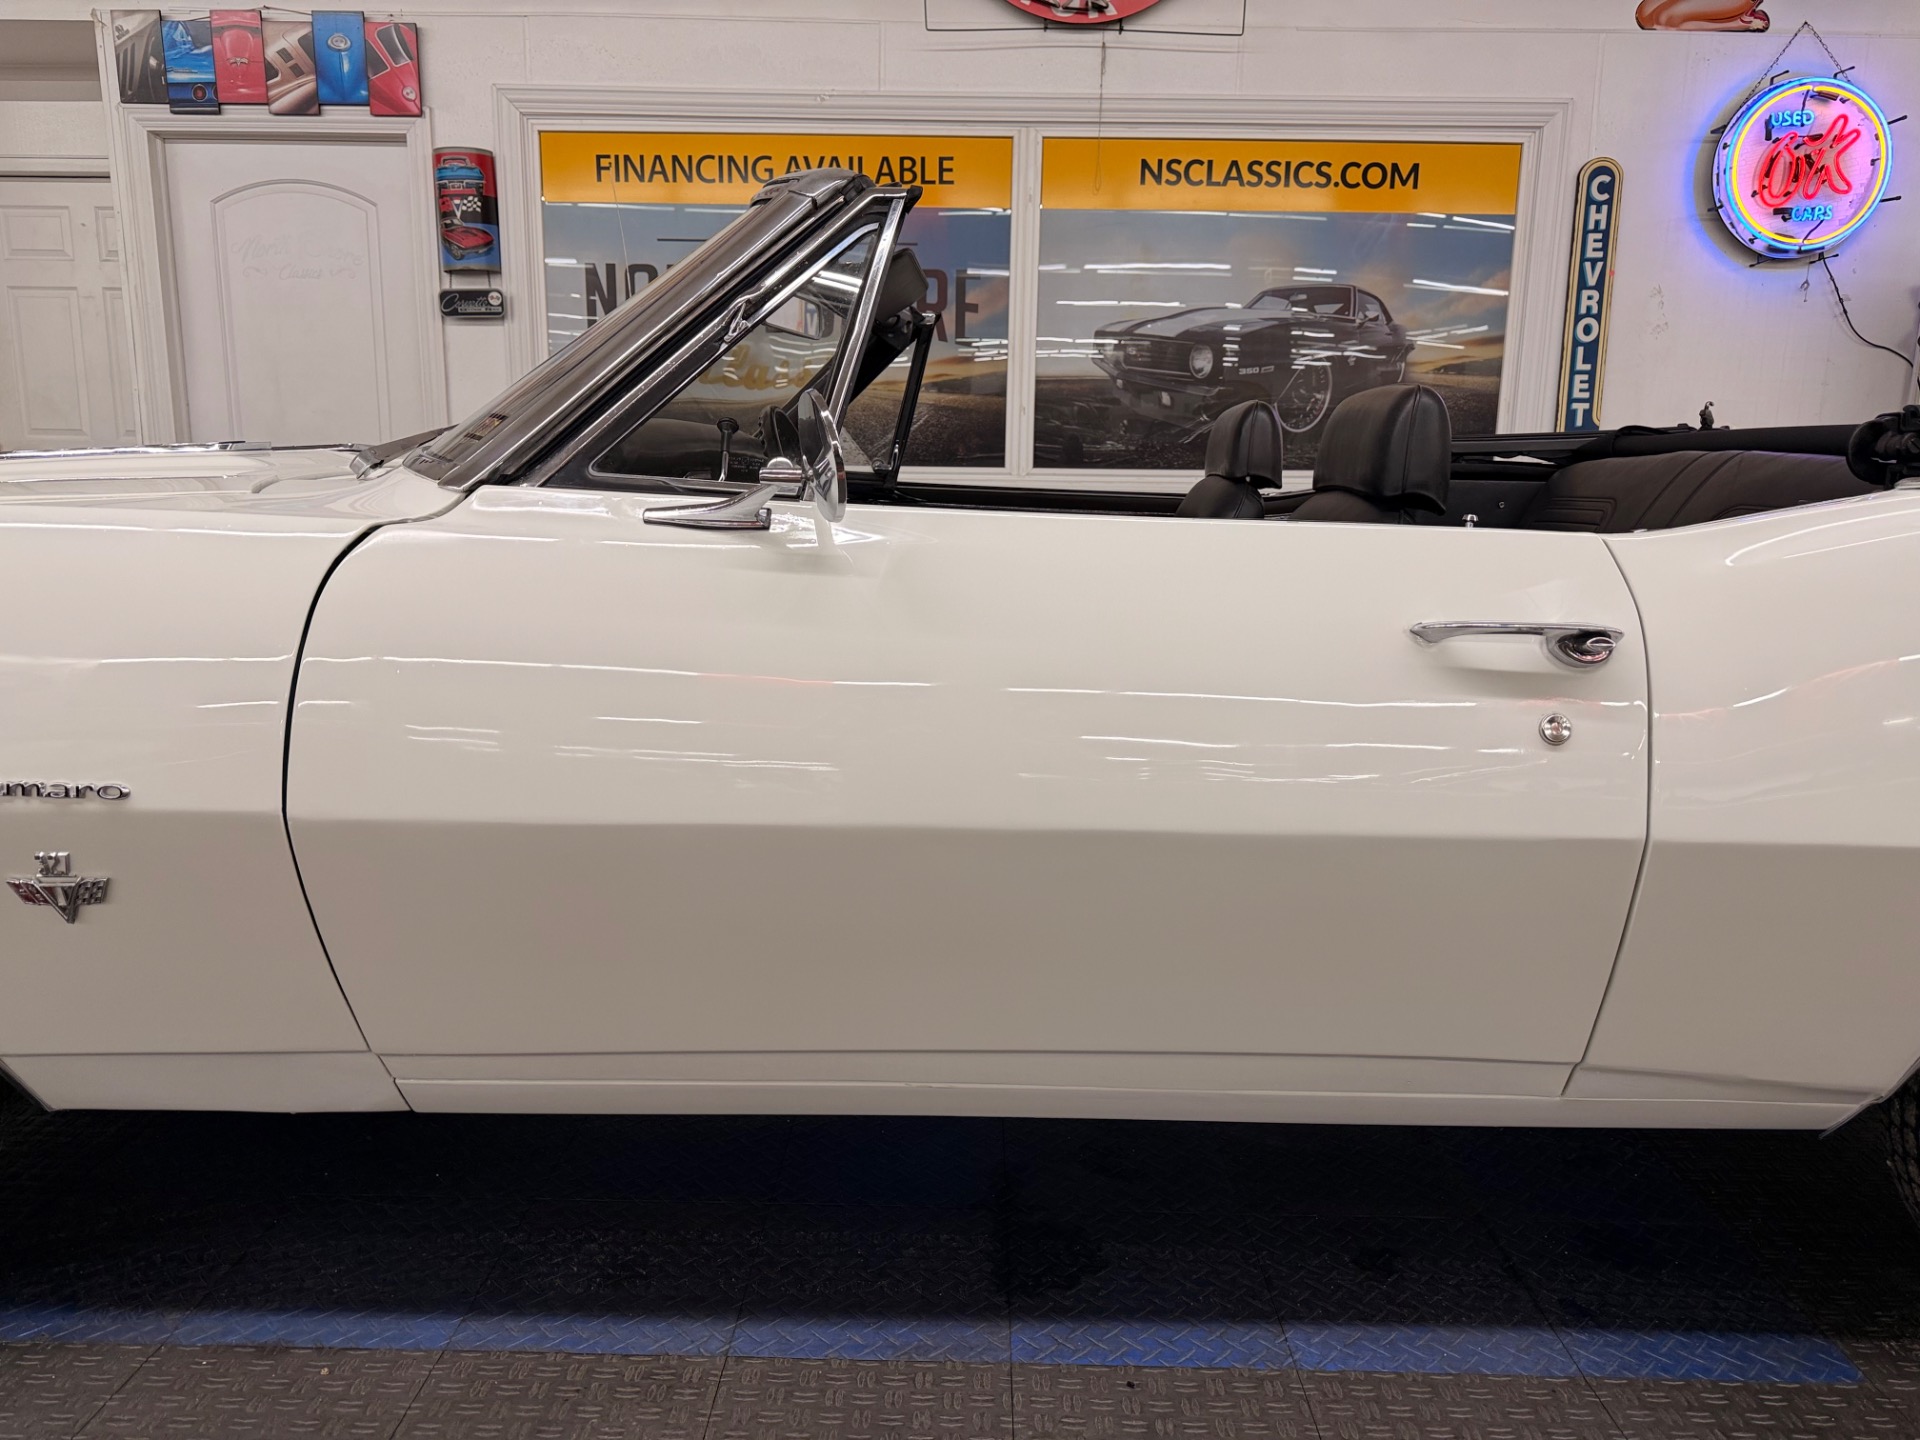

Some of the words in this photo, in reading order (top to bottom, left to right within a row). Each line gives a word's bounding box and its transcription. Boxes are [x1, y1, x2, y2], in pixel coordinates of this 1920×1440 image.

[1771, 109, 1815, 127] USED
[595, 154, 774, 184] FINANCING
[1140, 158, 1420, 190] NSCLASSICS.COM
[1758, 113, 1861, 208] OK
[1791, 204, 1833, 222] CARS
[1570, 174, 1612, 428] CHEVROLET
[0, 780, 131, 801] maro
